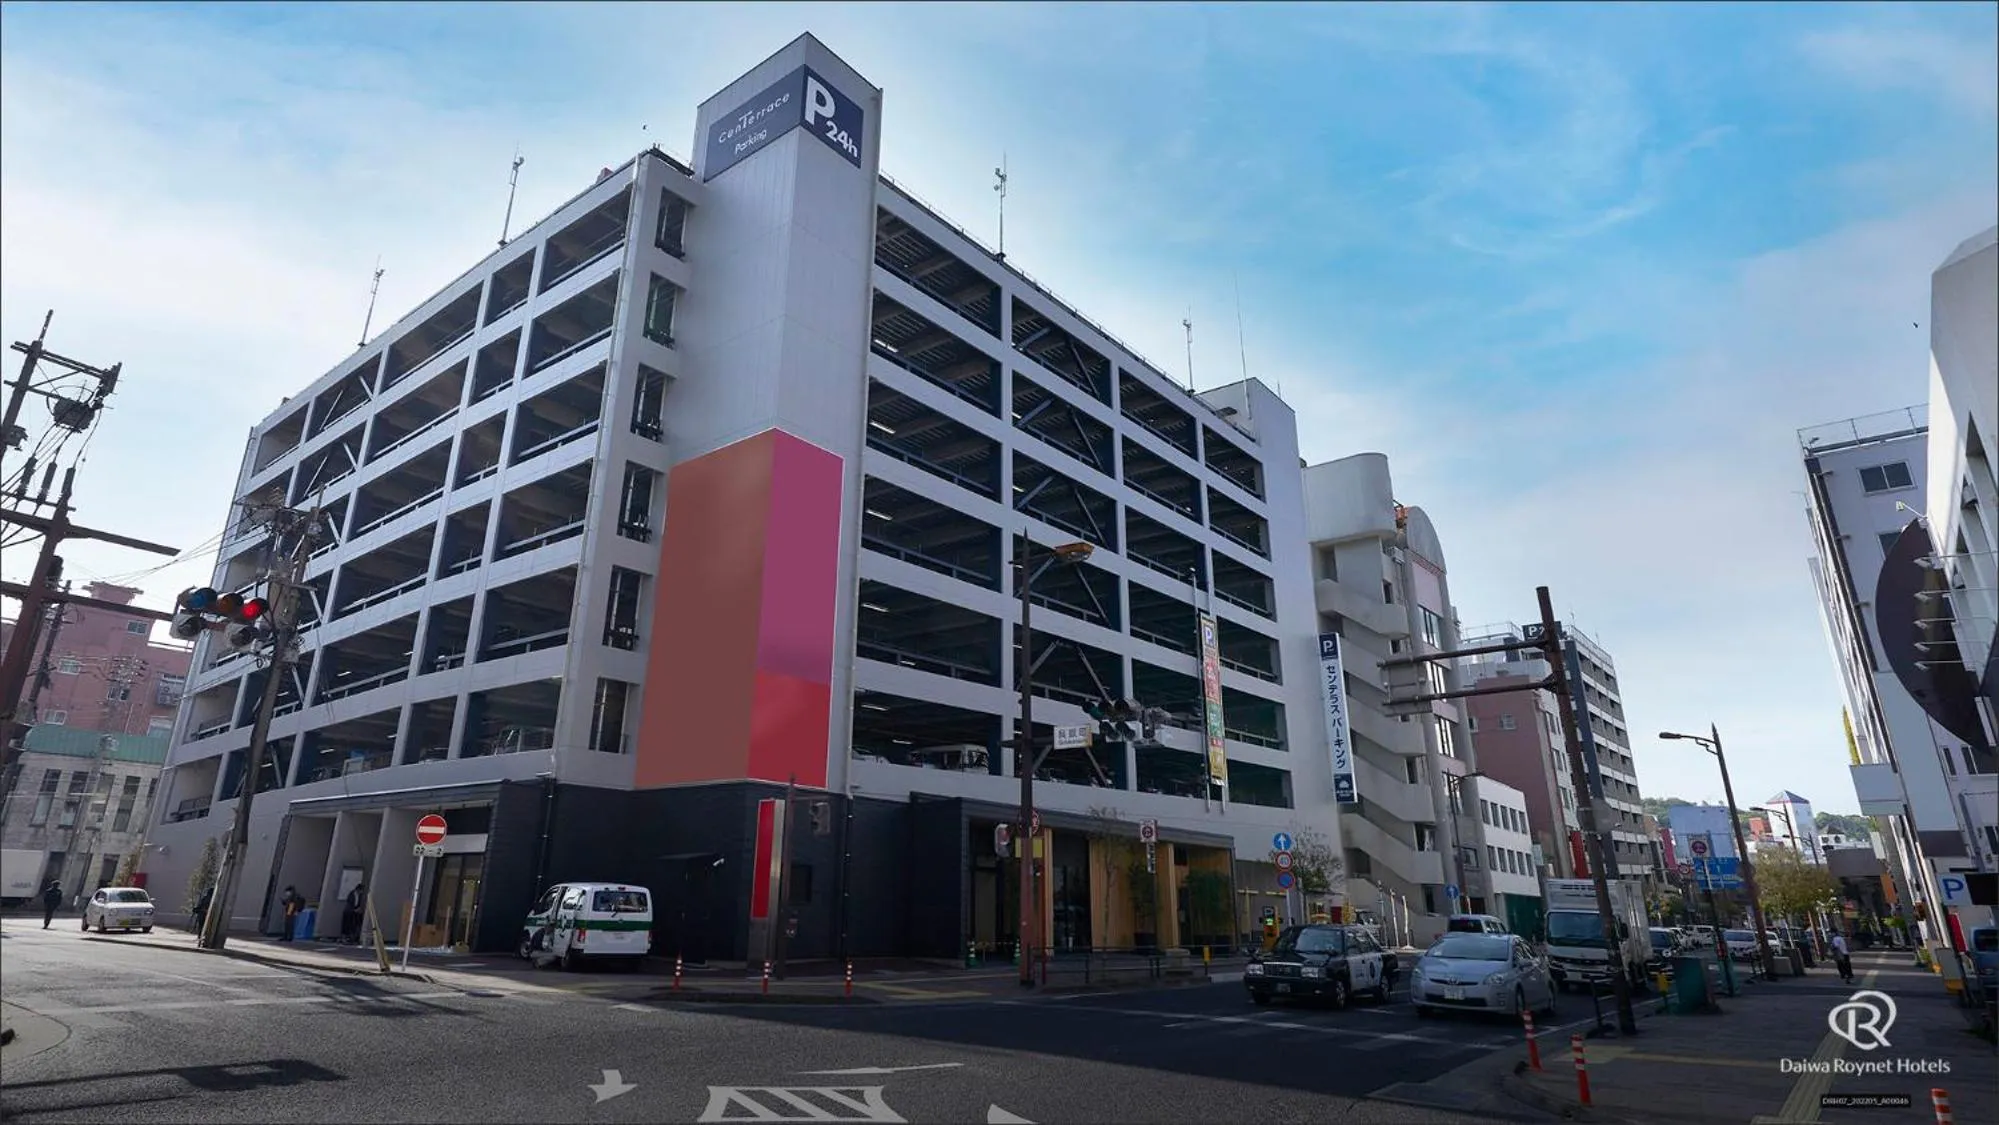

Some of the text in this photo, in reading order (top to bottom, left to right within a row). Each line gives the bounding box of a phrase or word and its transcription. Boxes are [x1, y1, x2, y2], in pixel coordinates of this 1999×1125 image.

[804, 76, 836, 126] P
[734, 129, 767, 155] Parking
[825, 120, 858, 158] 24h
[1323, 640, 1334, 653] P
[1942, 878, 1964, 900] P
